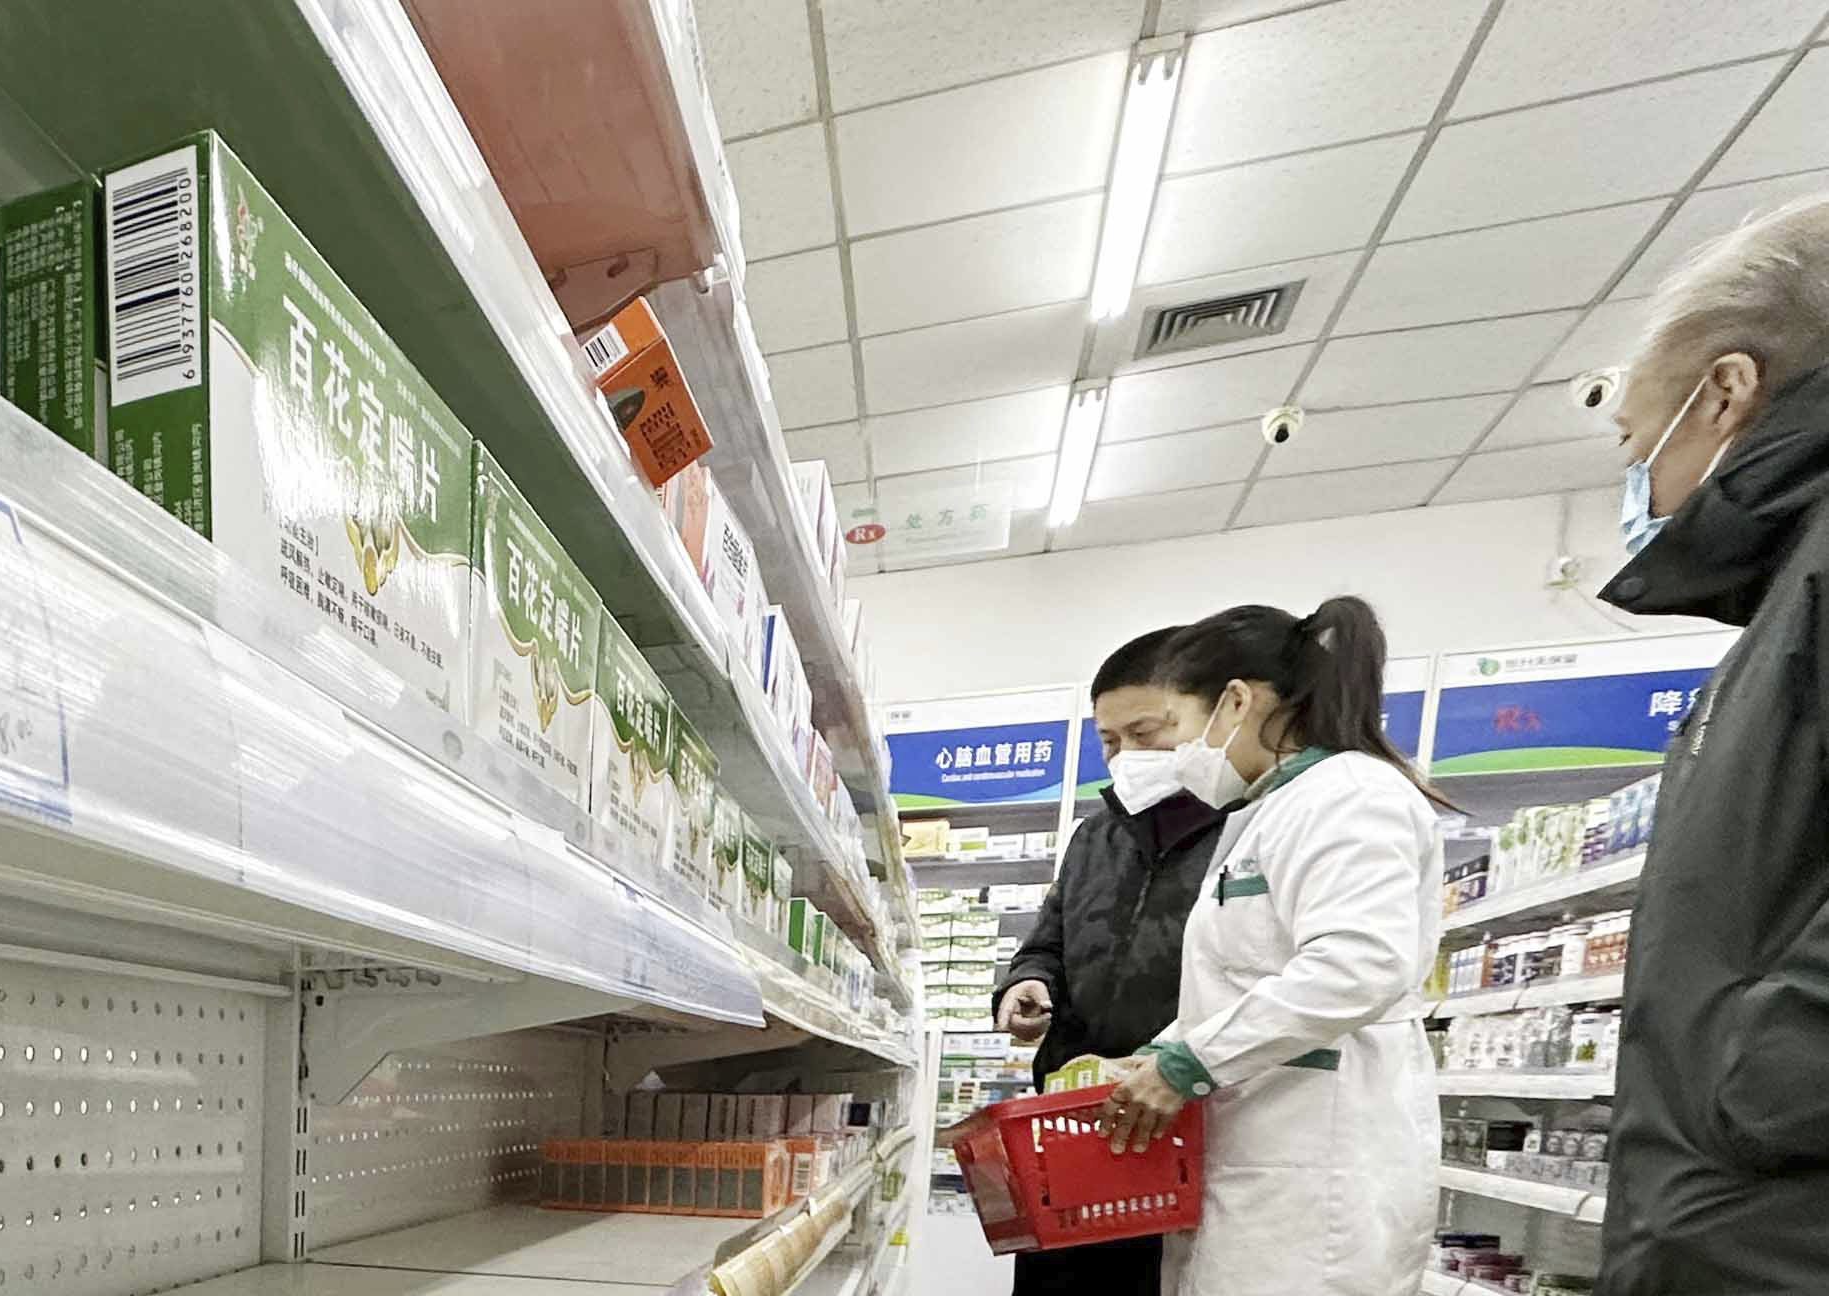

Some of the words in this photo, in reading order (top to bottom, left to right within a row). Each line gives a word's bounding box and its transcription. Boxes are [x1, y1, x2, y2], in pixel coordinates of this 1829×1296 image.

[178, 177, 193, 260] 268200
[180, 272, 195, 354] 937760
[182, 369, 196, 380] 6
[282, 294, 442, 523] 百花定喘片
[506, 537, 585, 671] 百花定喘片
[935, 739, 1053, 769] 心脑血管用药
